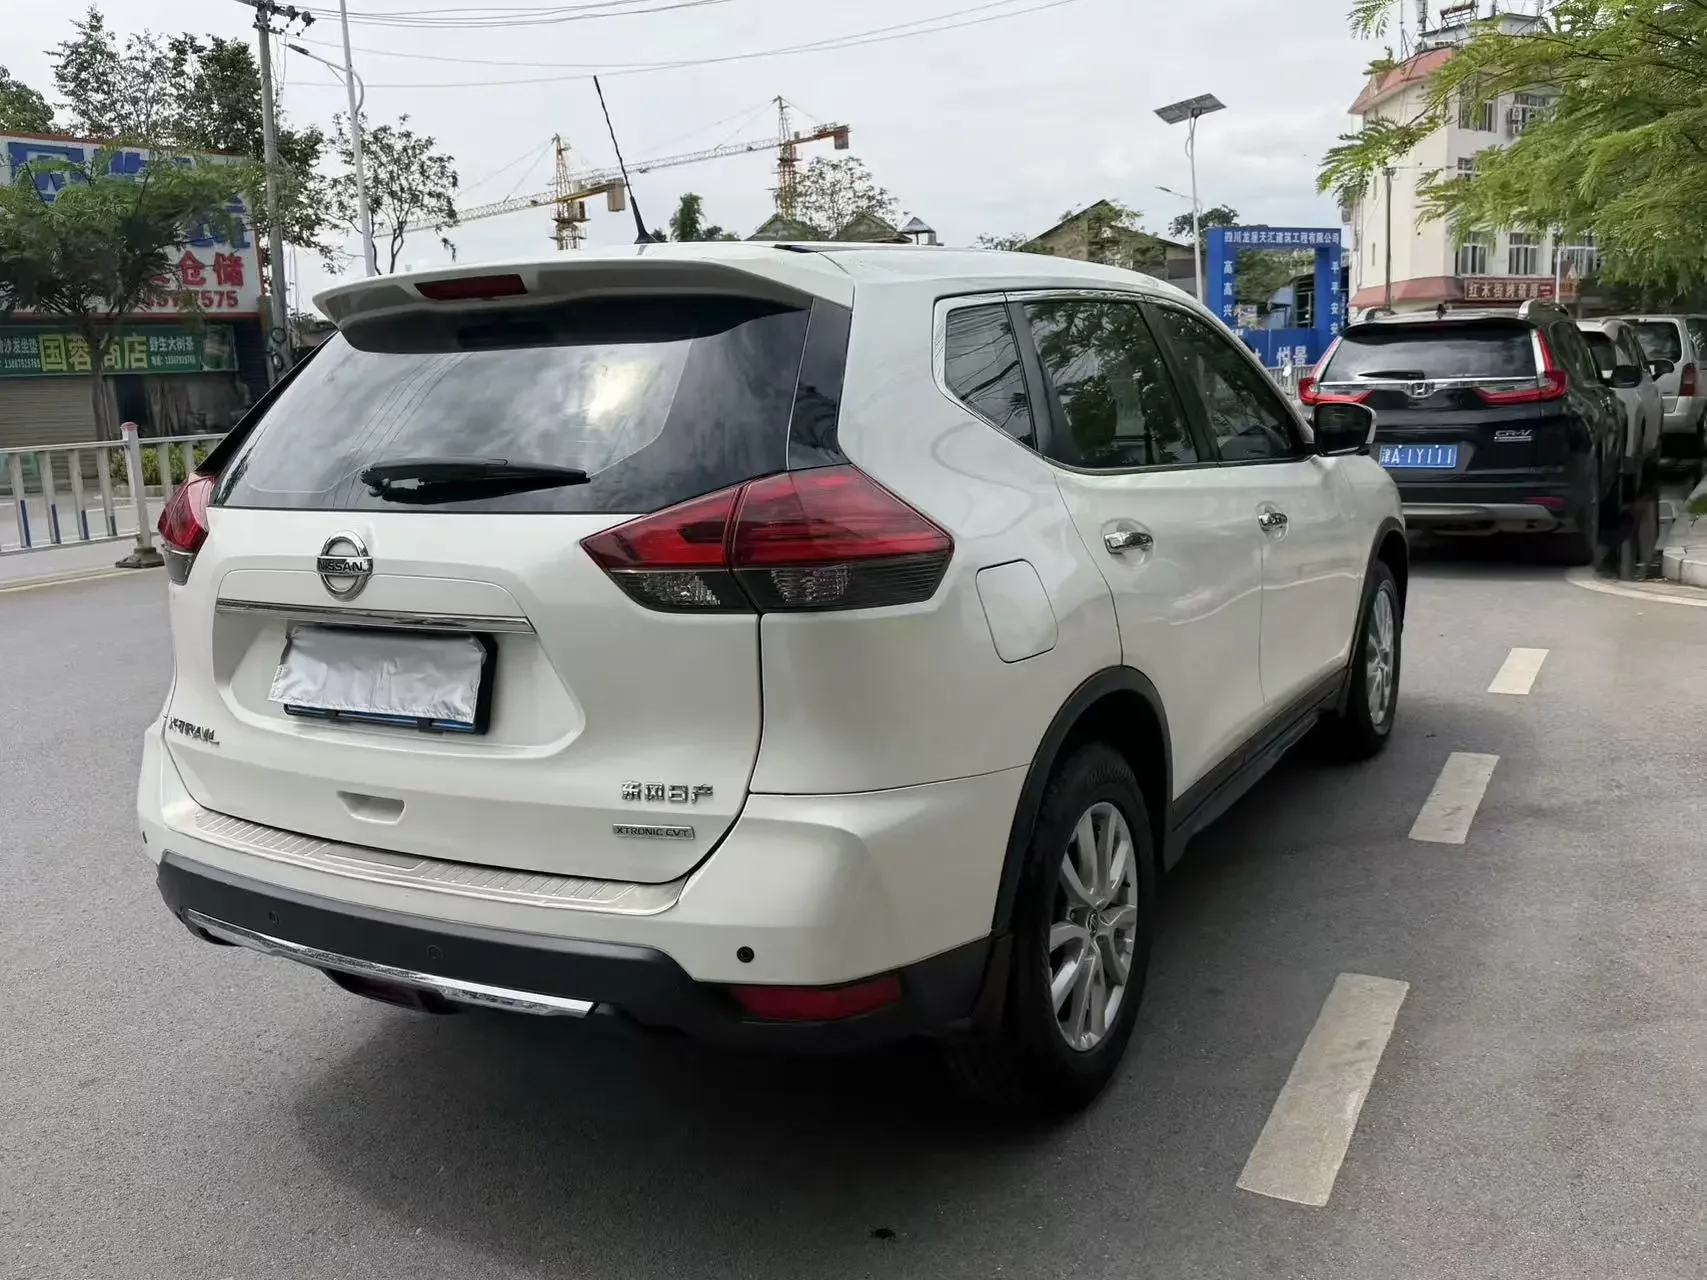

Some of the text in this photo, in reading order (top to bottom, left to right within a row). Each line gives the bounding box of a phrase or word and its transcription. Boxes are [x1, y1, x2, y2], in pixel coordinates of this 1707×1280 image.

[154, 251, 244, 287] 仓储
[320, 561, 363, 571] NISSAN
[622, 780, 713, 803] 东风日产
[616, 826, 690, 837] XTRONIC CVT
